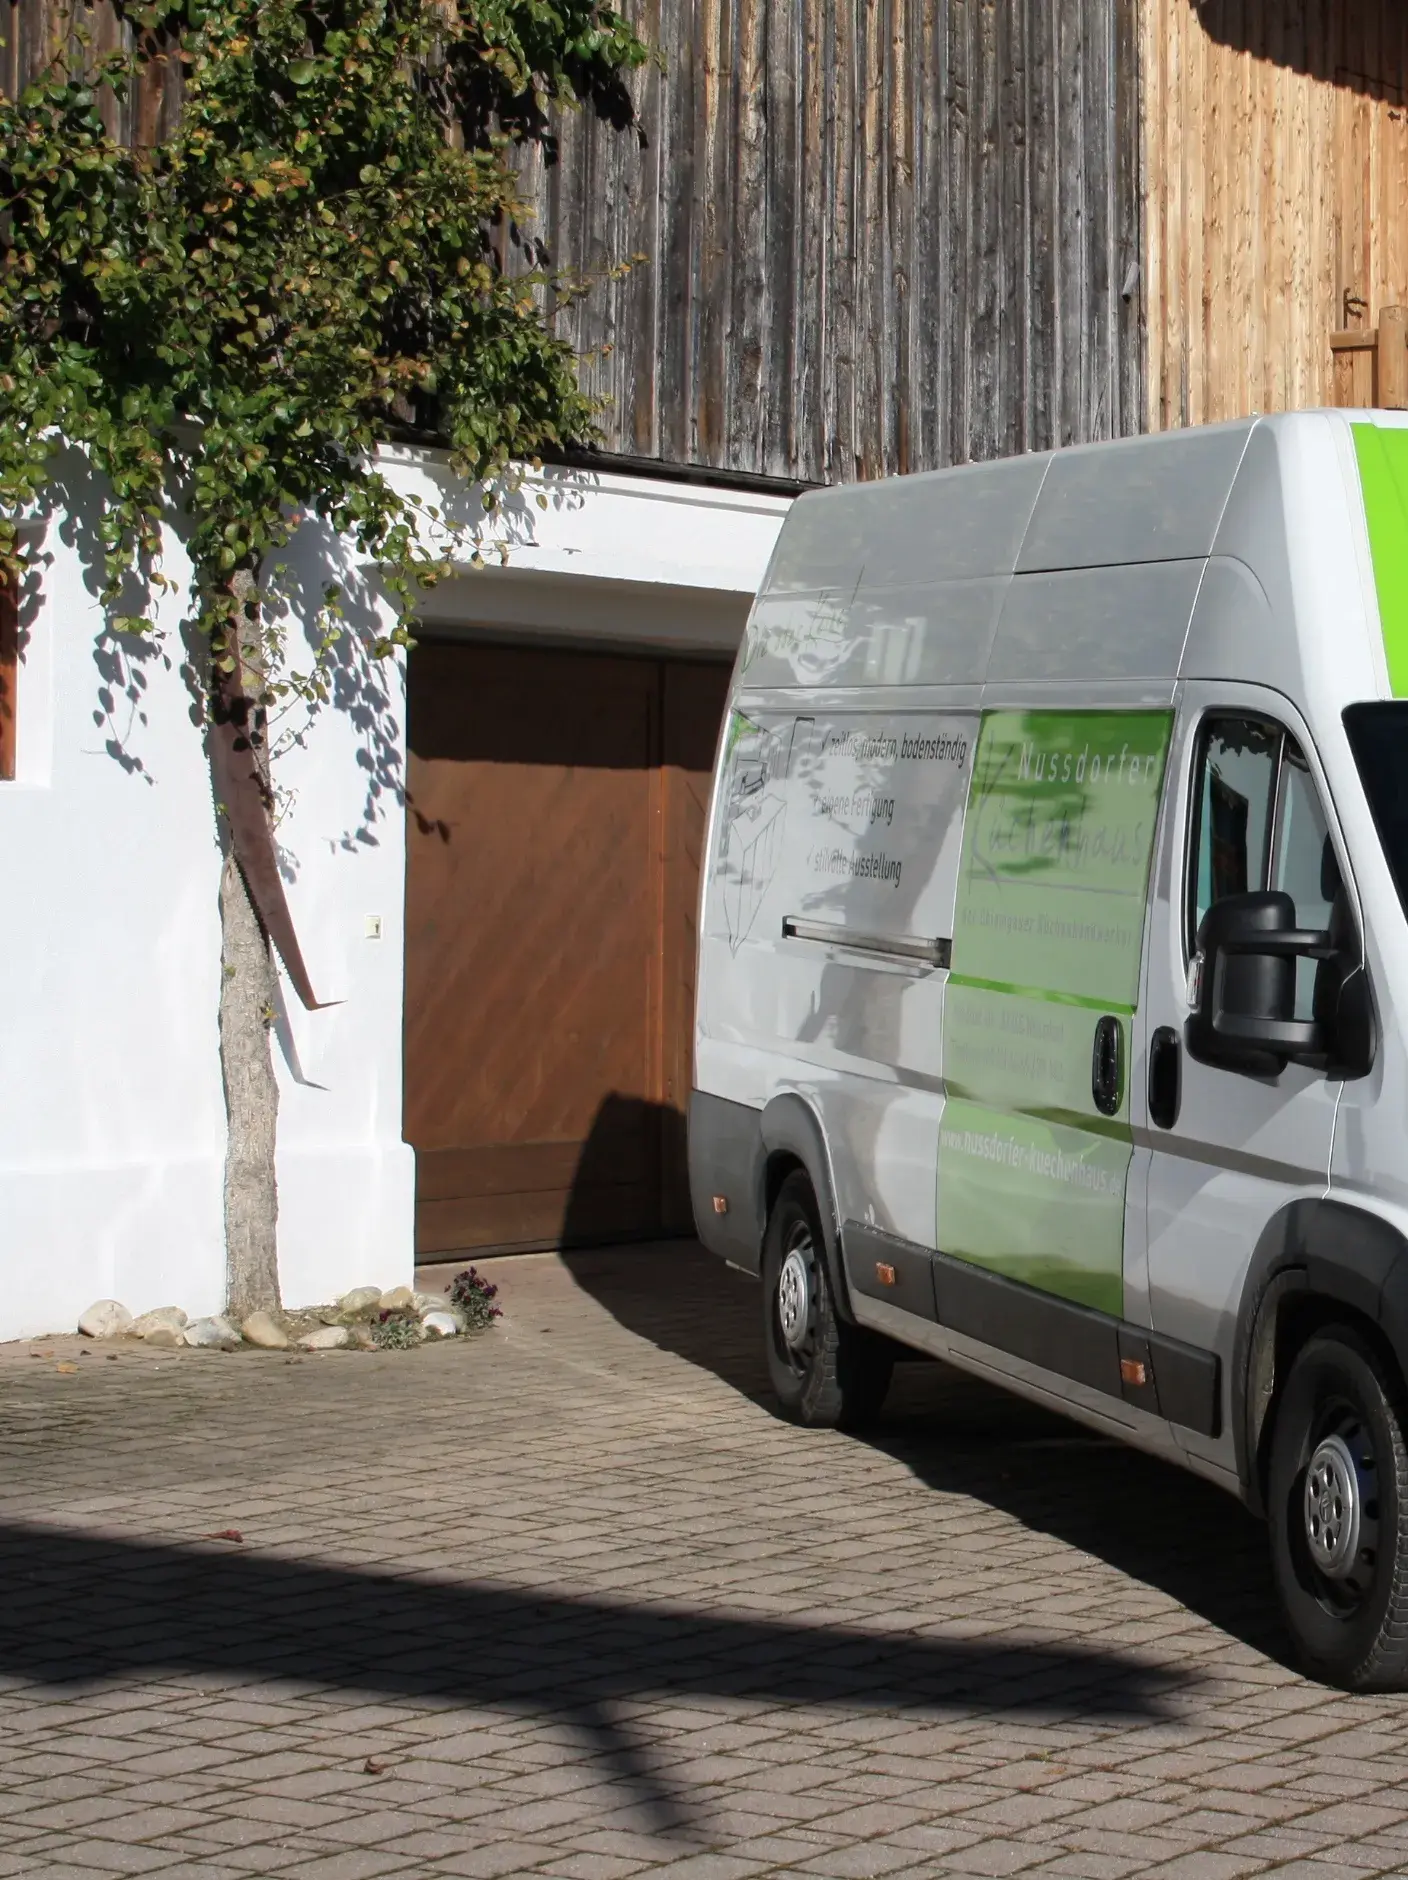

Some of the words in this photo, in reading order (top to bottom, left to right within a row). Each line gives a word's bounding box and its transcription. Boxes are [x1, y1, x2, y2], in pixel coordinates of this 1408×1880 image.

[900, 732, 967, 769] bodenständig
[1017, 741, 1155, 785] Nussdorfer
[849, 850, 902, 888] Ausstellung
